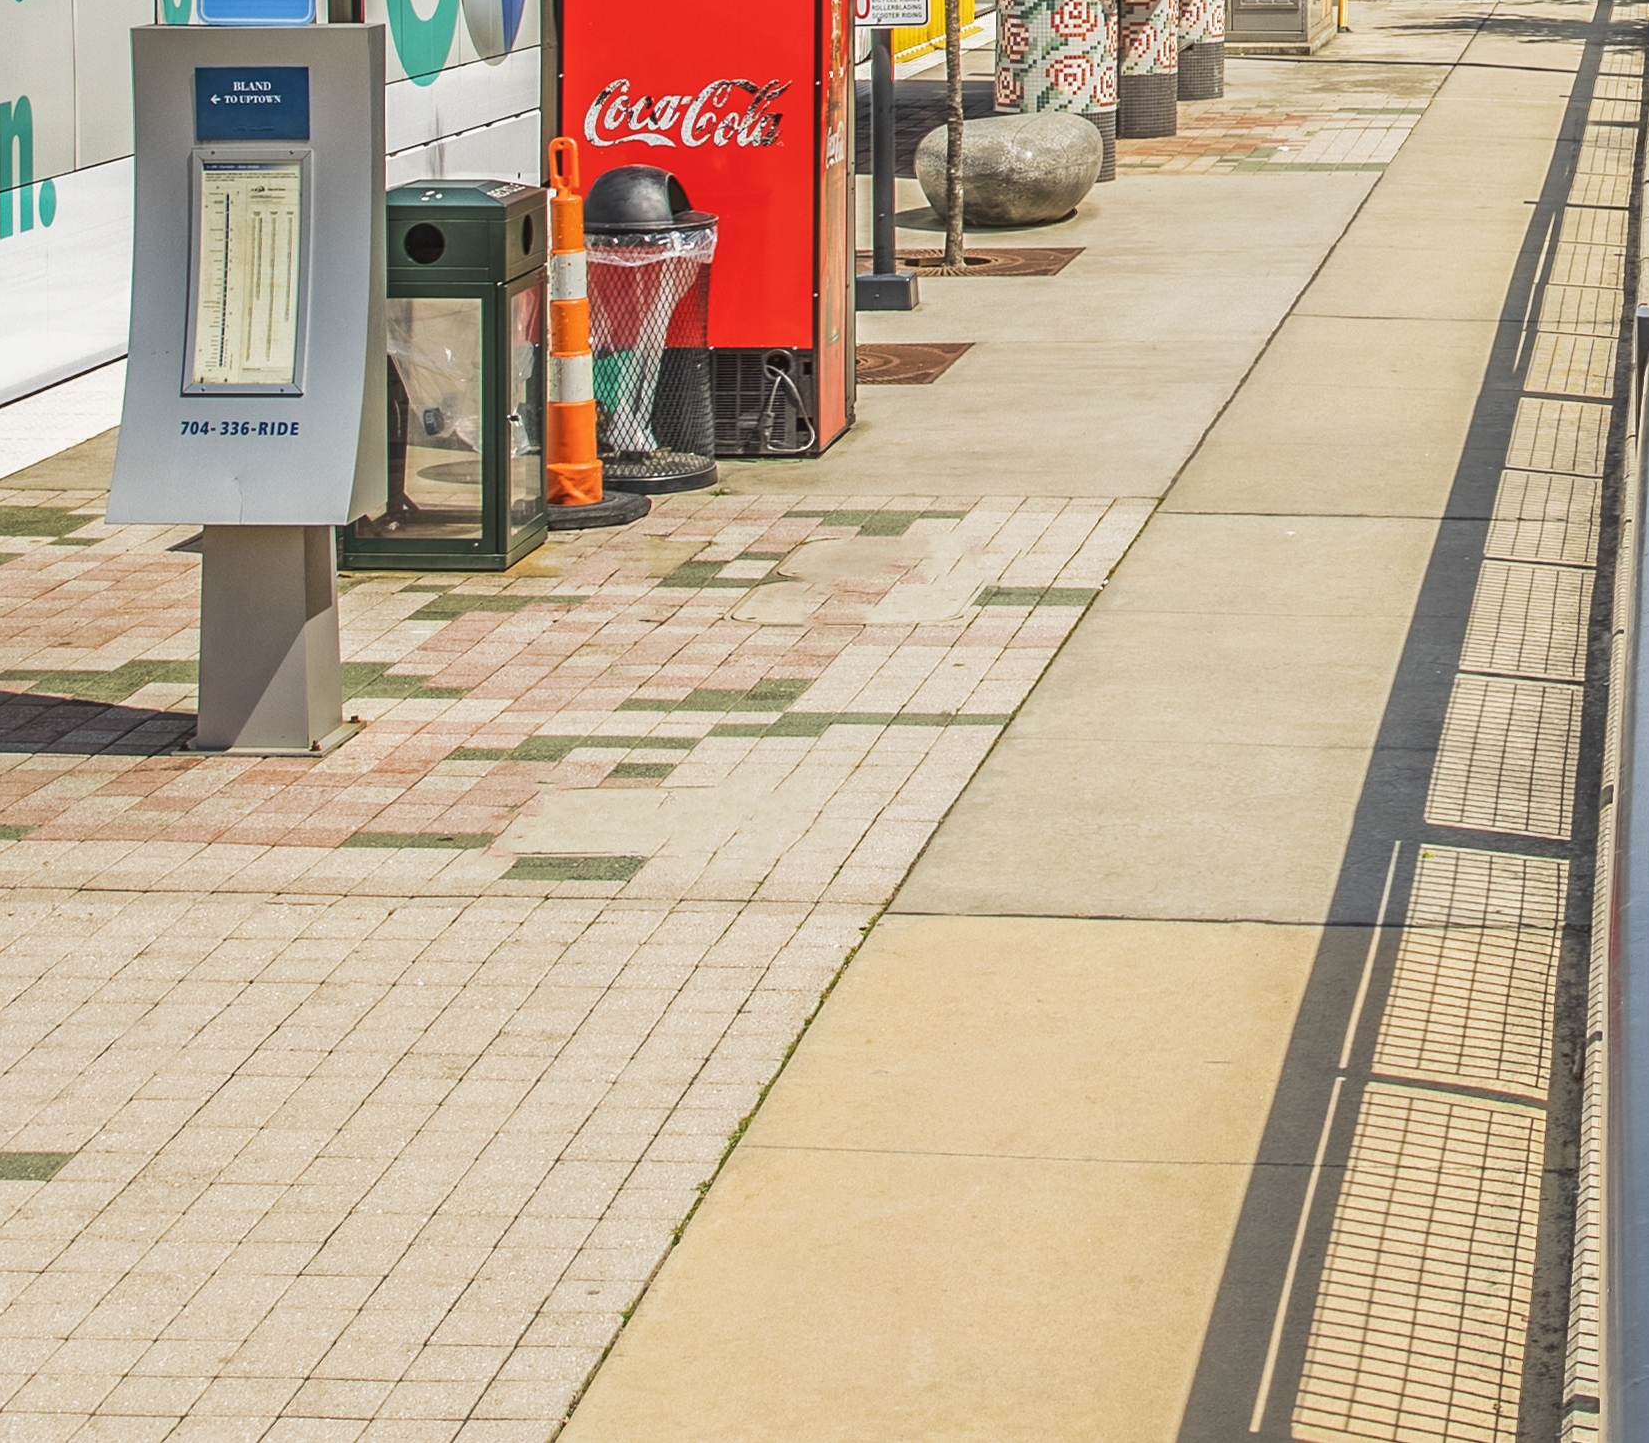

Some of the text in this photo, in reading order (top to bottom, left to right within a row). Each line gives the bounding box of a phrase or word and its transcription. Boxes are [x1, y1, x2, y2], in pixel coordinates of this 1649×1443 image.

[232, 81, 272, 92] BLAND
[224, 94, 282, 104] TO UPTOWN
[583, 77, 794, 148] Coca-Cola
